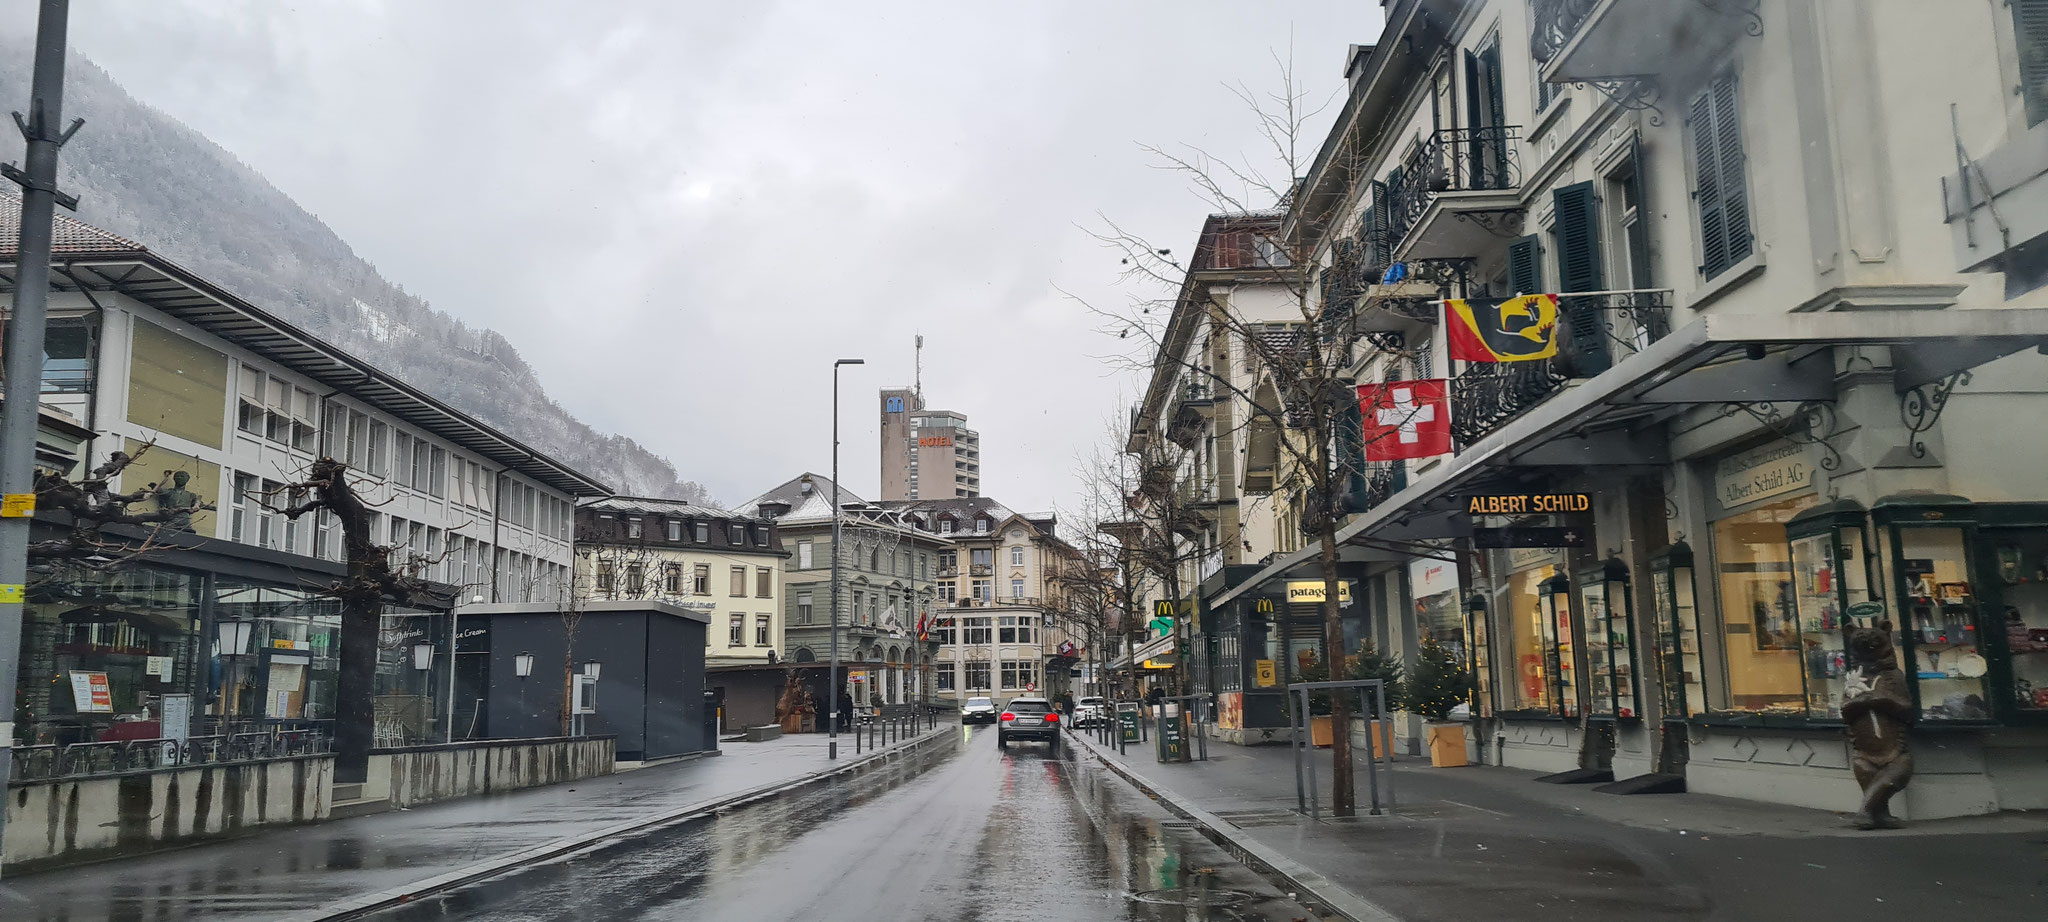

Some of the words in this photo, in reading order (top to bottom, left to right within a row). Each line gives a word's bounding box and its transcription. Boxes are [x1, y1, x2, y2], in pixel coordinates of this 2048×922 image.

[919, 436, 953, 447] HOTEL
[1726, 482, 1753, 501] Albert
[1754, 468, 1783, 493] Schild
[1786, 463, 1803, 485] AG
[1469, 496, 1528, 513] ALBERT
[1533, 494, 1589, 512] SCHILD
[1290, 588, 1346, 598] patagoa
[464, 628, 487, 638] Cream
